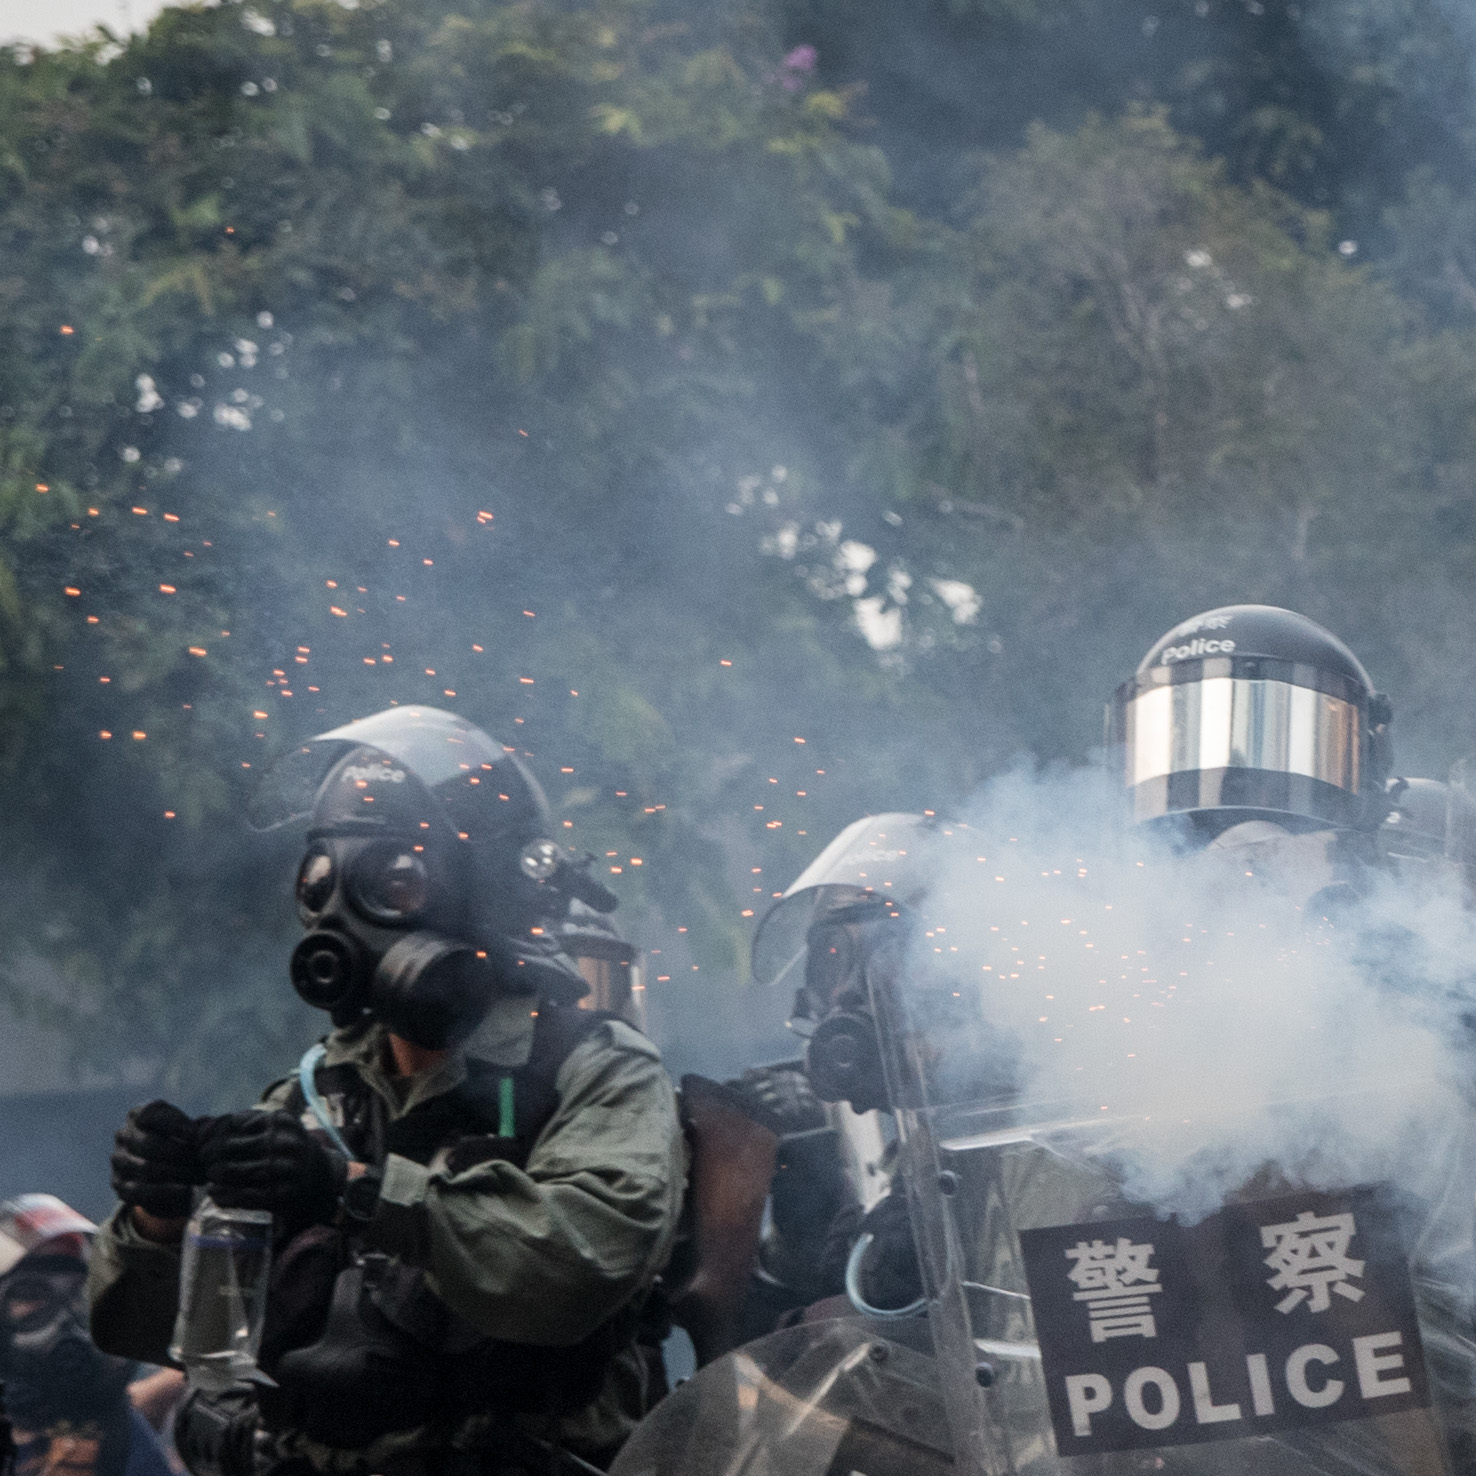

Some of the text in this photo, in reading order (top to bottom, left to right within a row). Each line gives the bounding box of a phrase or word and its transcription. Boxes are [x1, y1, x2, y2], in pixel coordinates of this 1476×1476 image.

[1161, 637, 1236, 666] Police
[1064, 1210, 1366, 1343] 警察
[1064, 1330, 1412, 1438] POLICE
